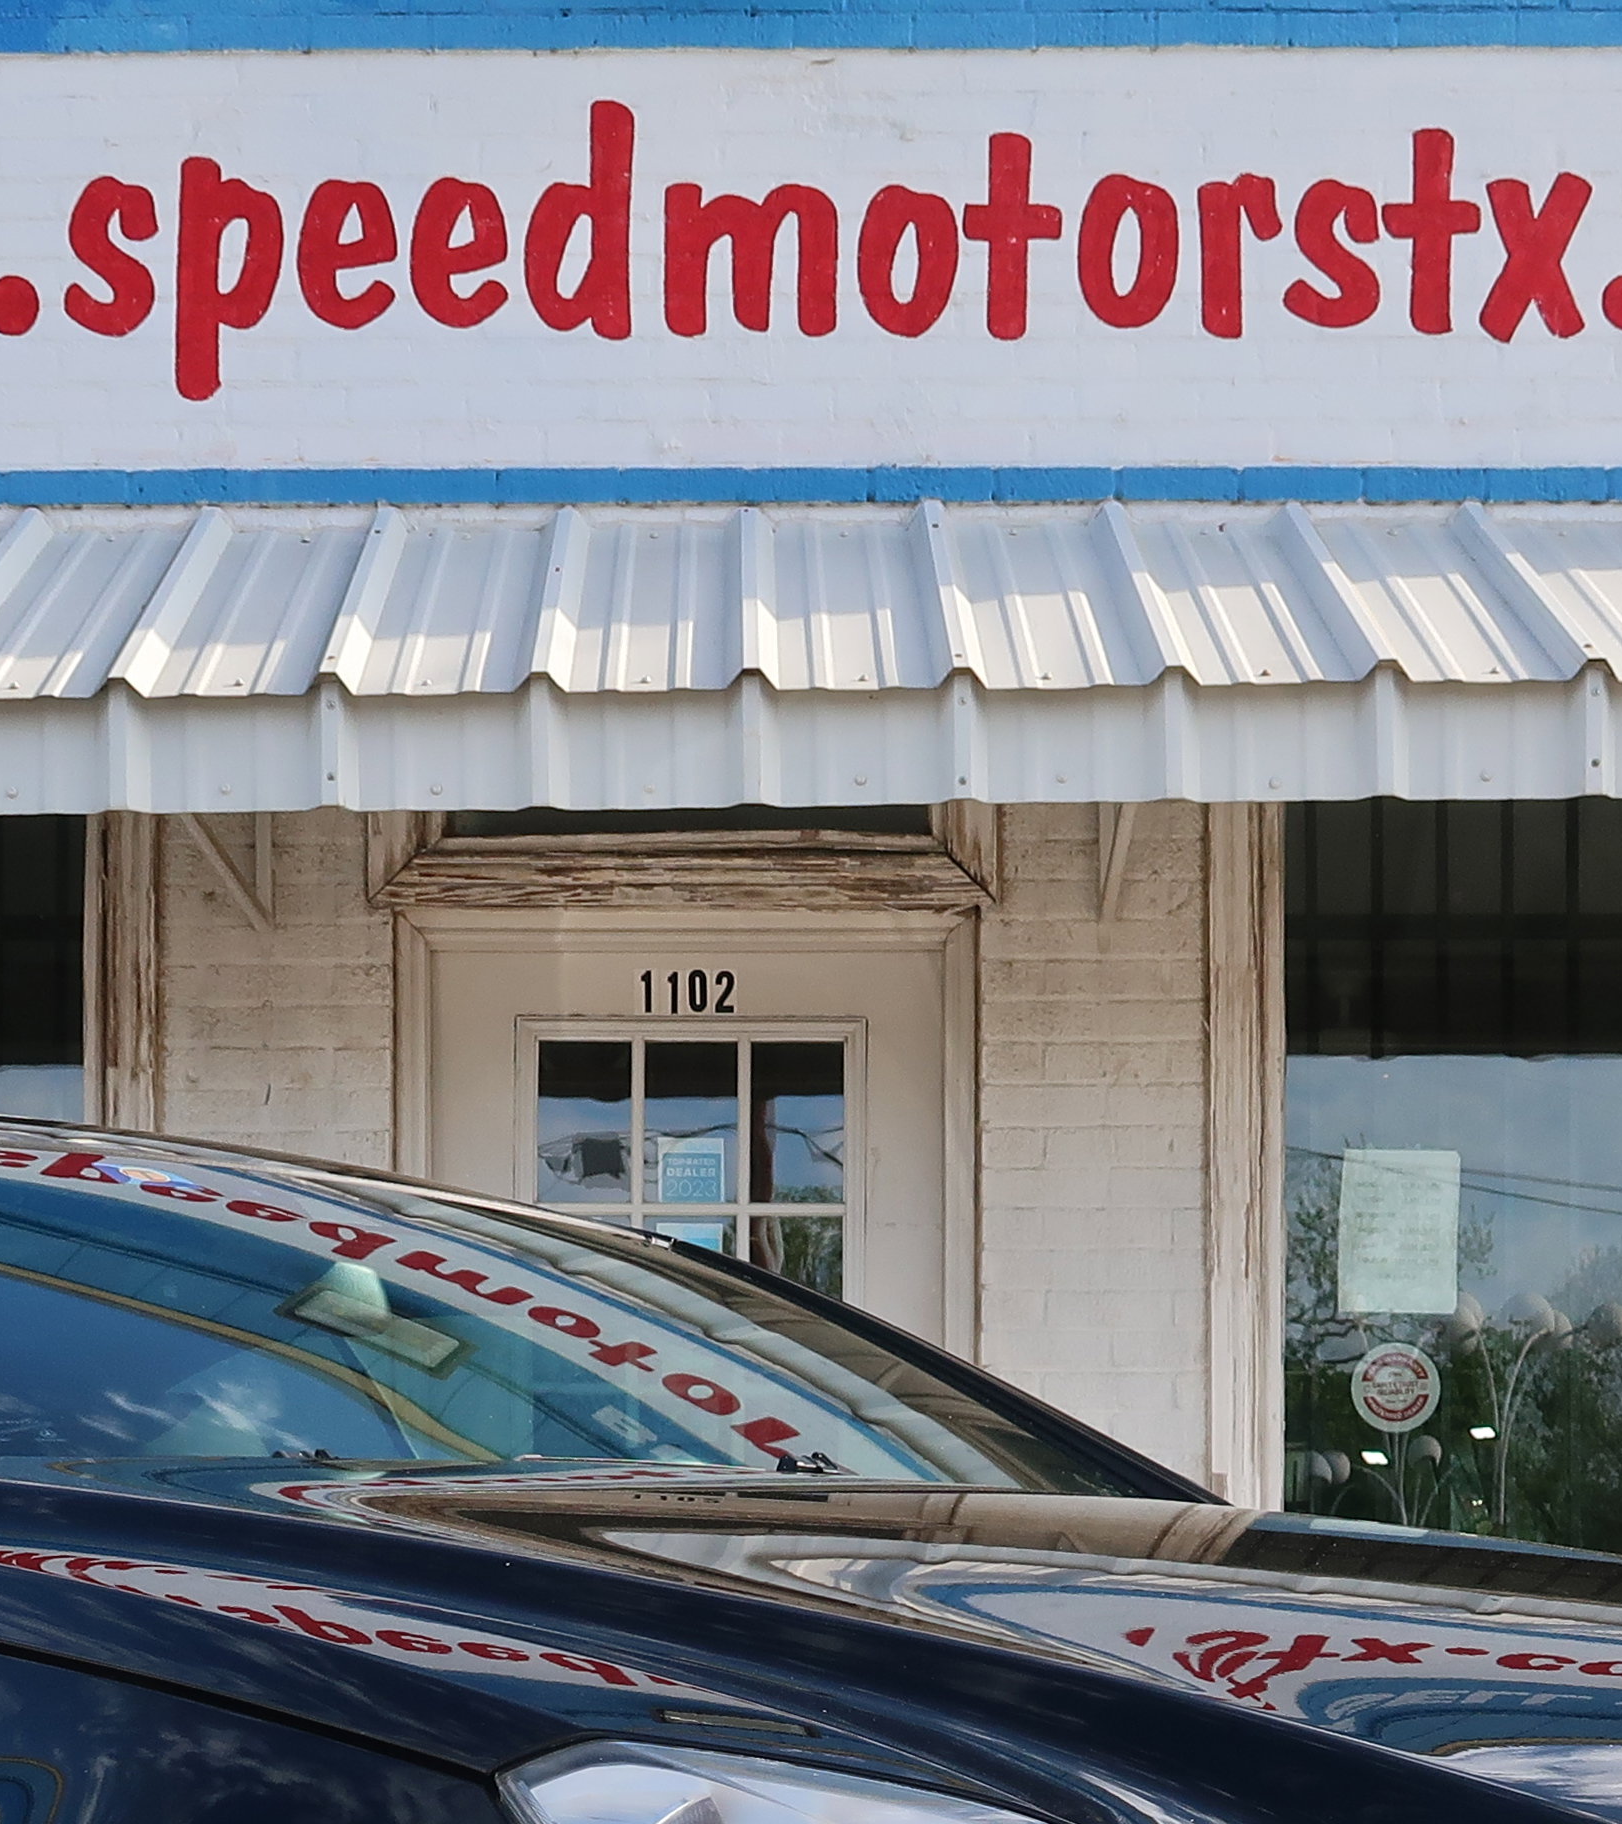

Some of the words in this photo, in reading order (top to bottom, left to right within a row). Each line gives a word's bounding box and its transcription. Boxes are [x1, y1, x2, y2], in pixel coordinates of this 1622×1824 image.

[640, 969, 735, 1014] 1102
[666, 1167, 716, 1177] DEALER
[666, 1179, 717, 1197] 2023
